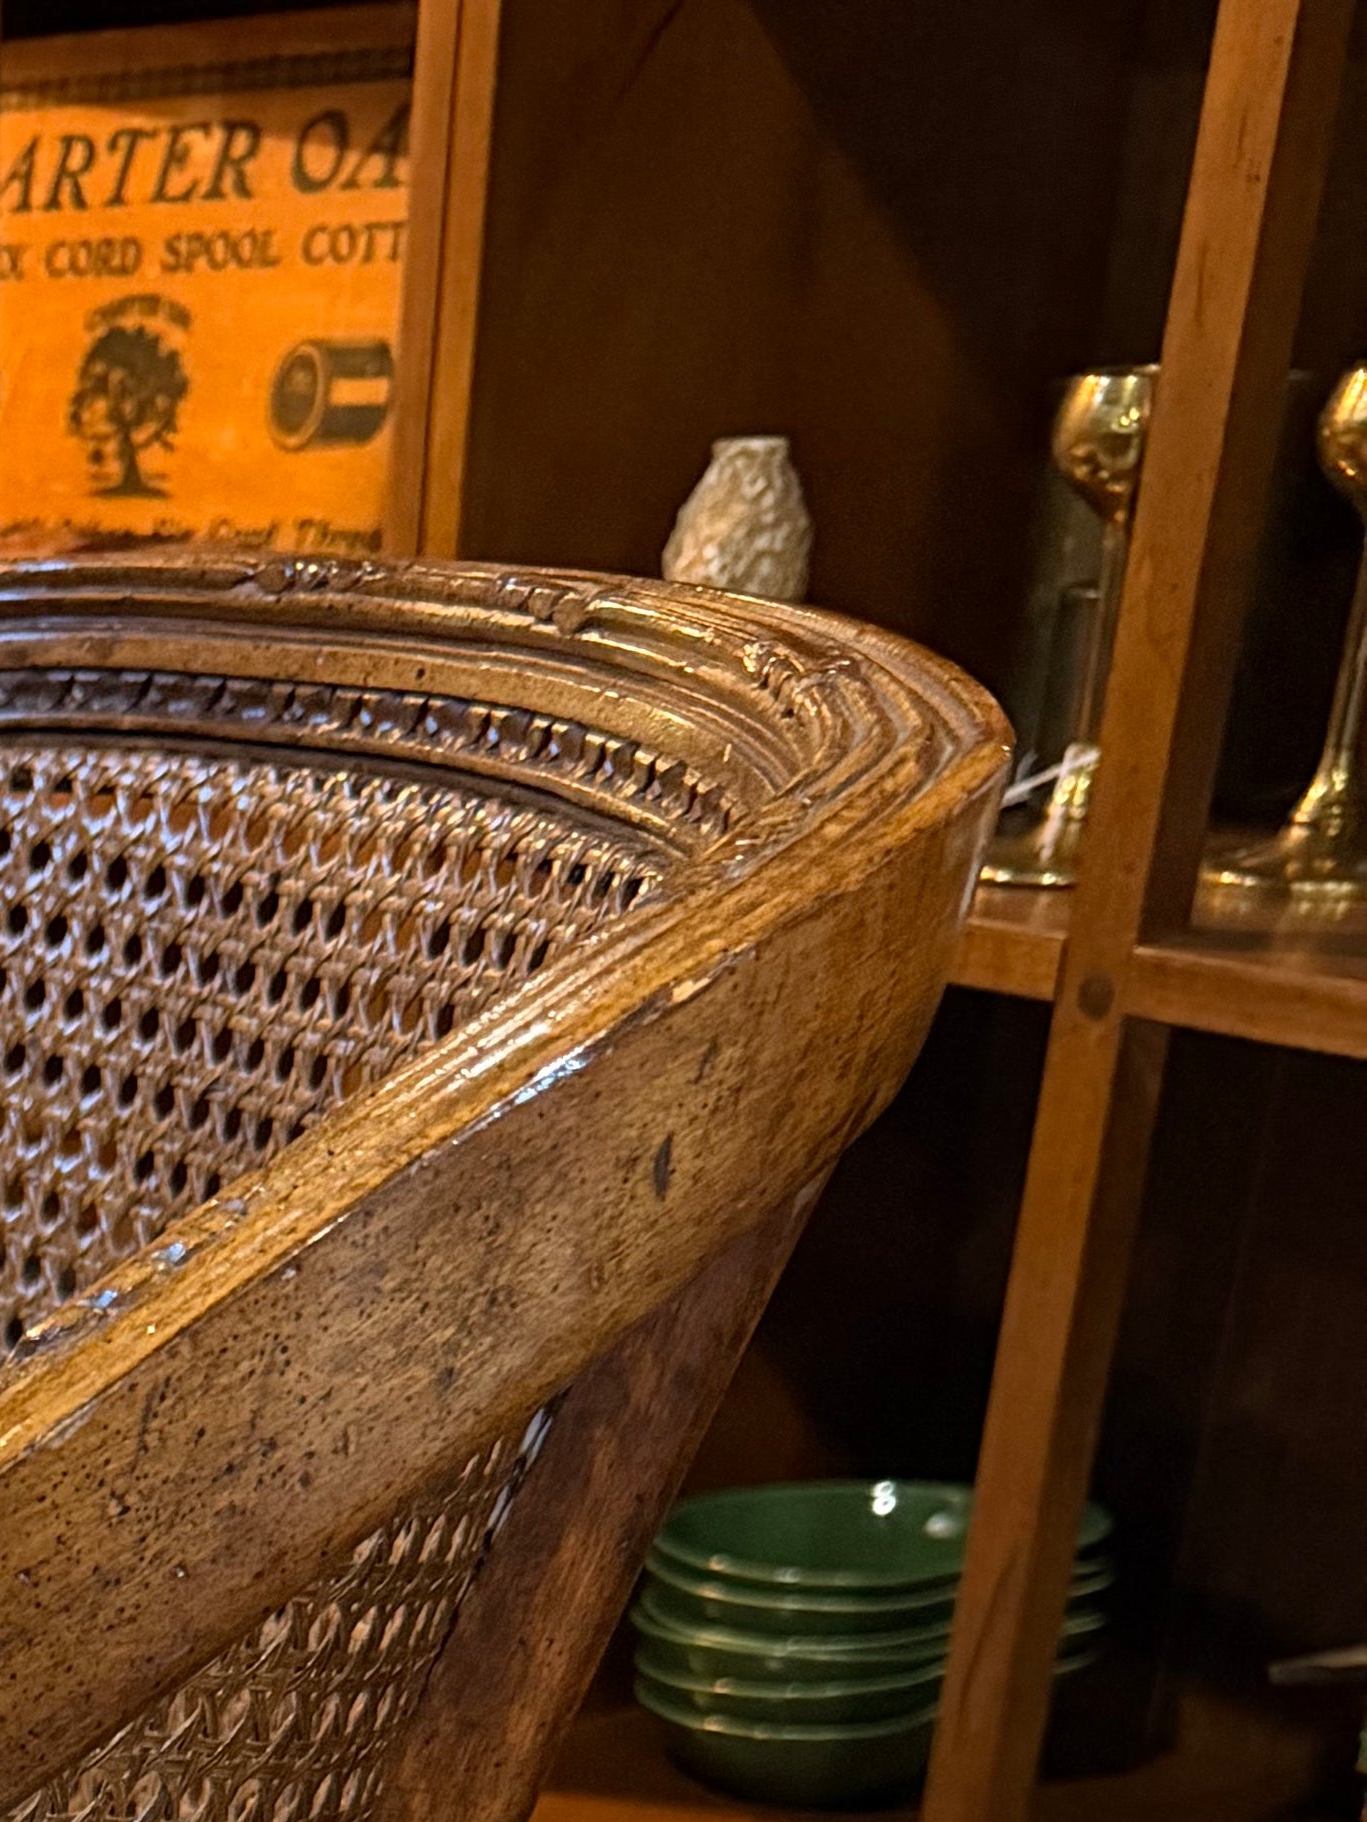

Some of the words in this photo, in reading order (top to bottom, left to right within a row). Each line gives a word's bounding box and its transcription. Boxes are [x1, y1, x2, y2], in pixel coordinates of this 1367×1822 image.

[291, 102, 413, 194] OA
[45, 235, 144, 279] CORD
[160, 227, 282, 275] SPOOL
[301, 220, 407, 266] COTT
